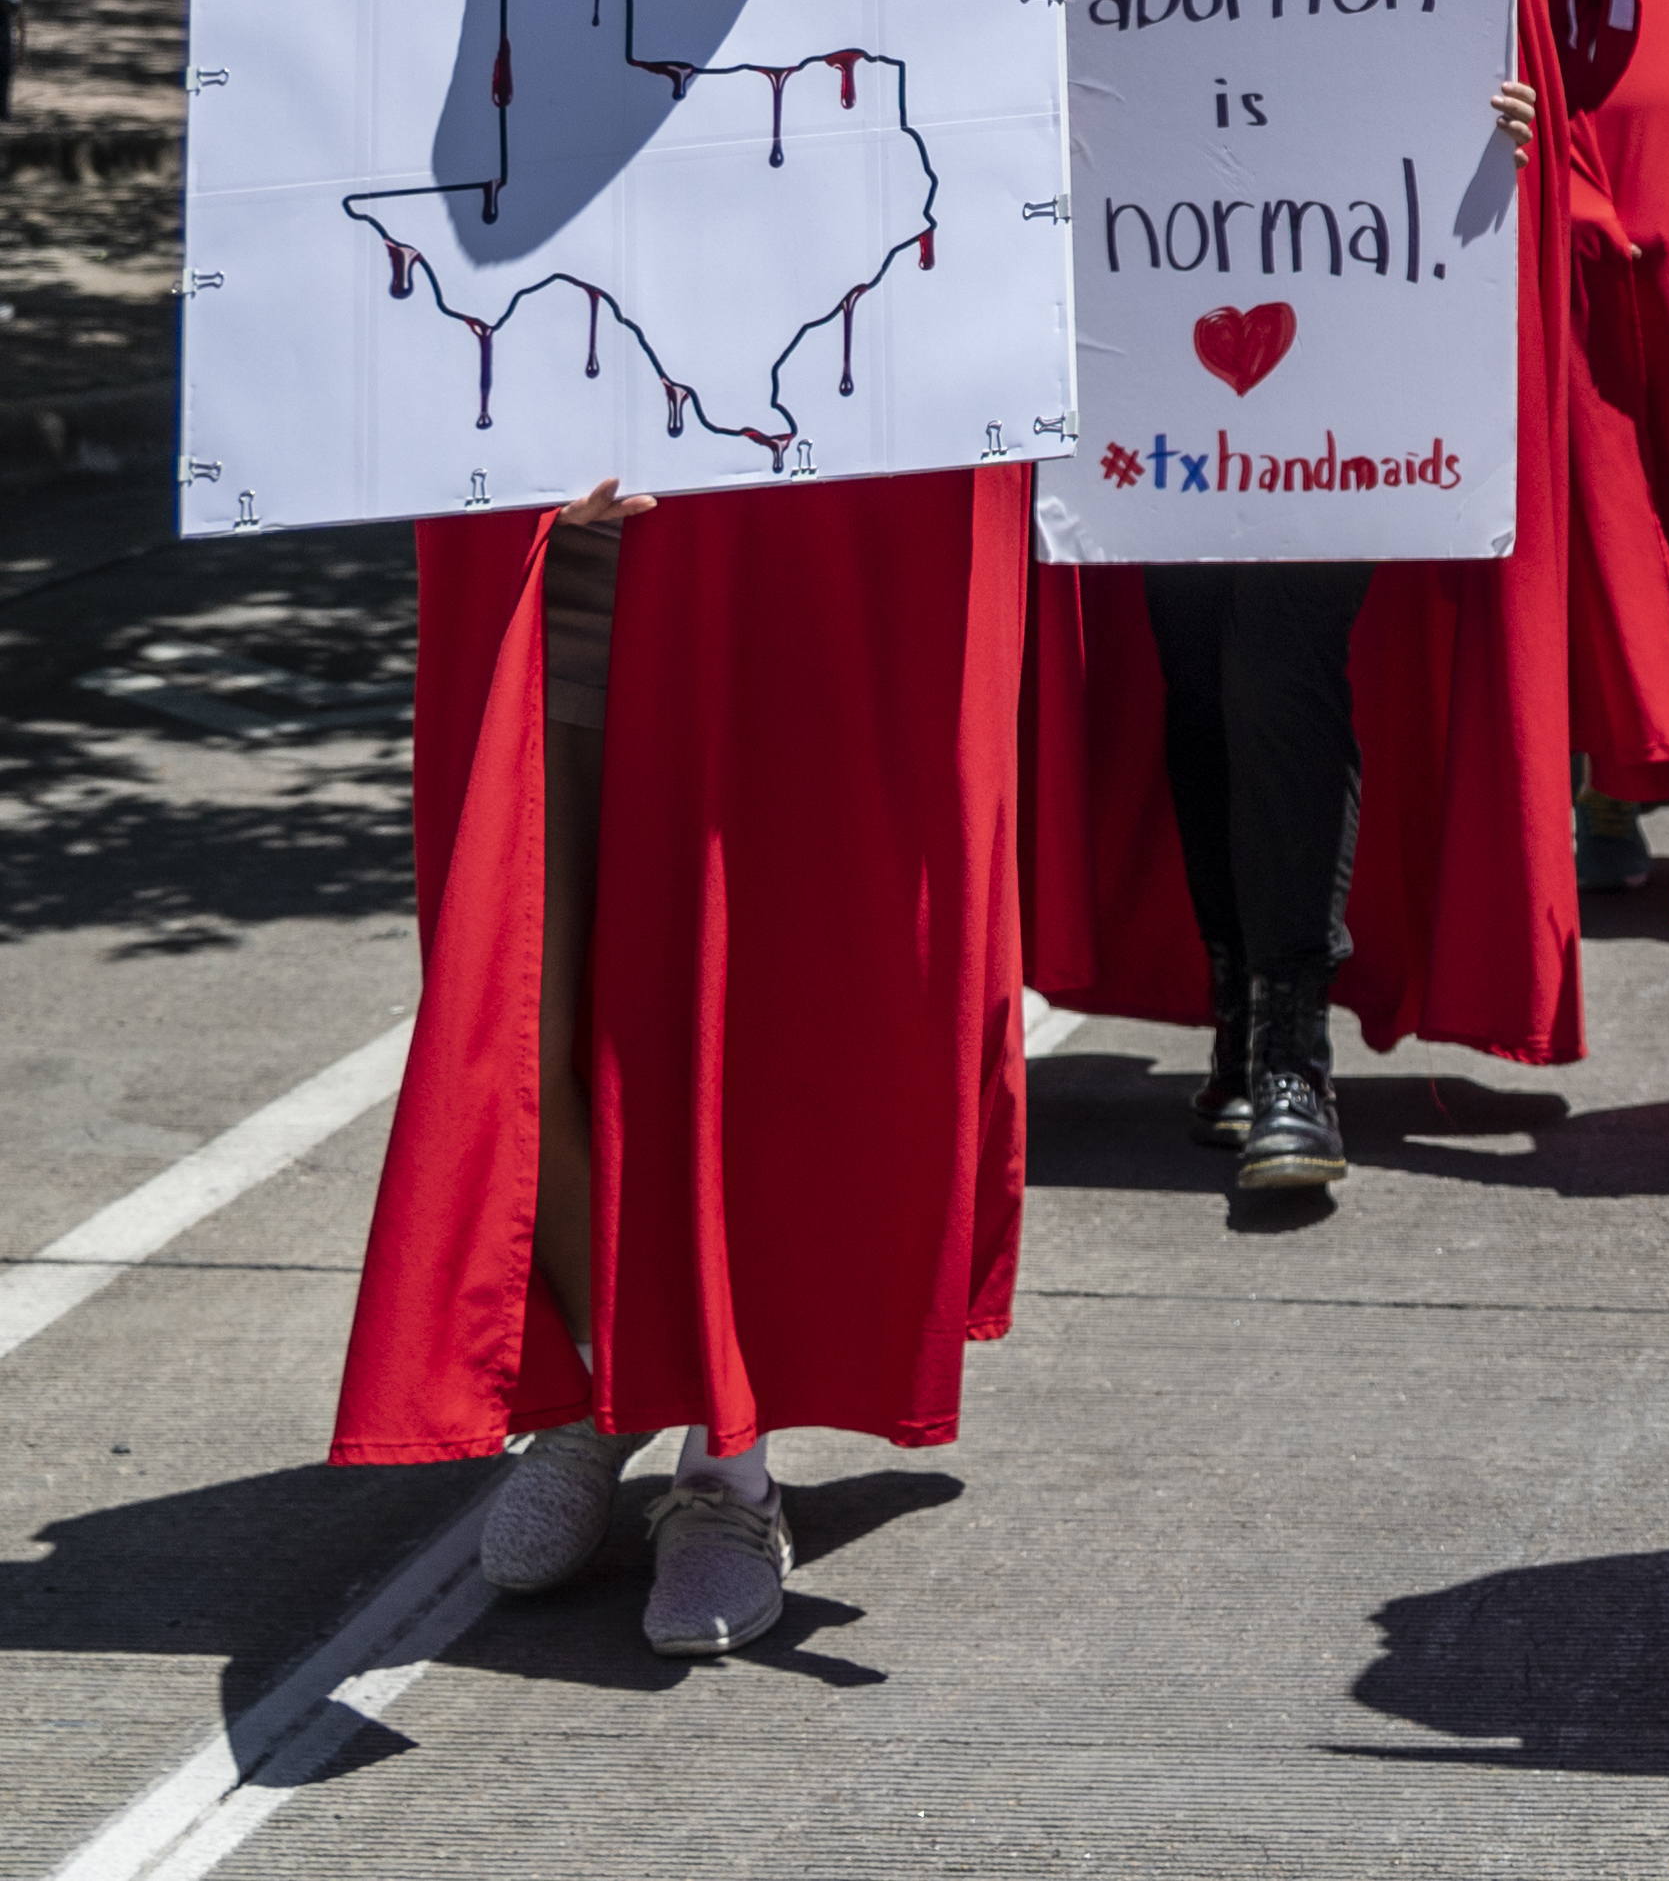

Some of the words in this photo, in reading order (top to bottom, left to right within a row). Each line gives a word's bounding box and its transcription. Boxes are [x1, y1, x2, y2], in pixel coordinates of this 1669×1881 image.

[1214, 77, 1269, 130] is
[1105, 156, 1447, 284] normal.
[1099, 428, 1463, 494] #txhandmaids
